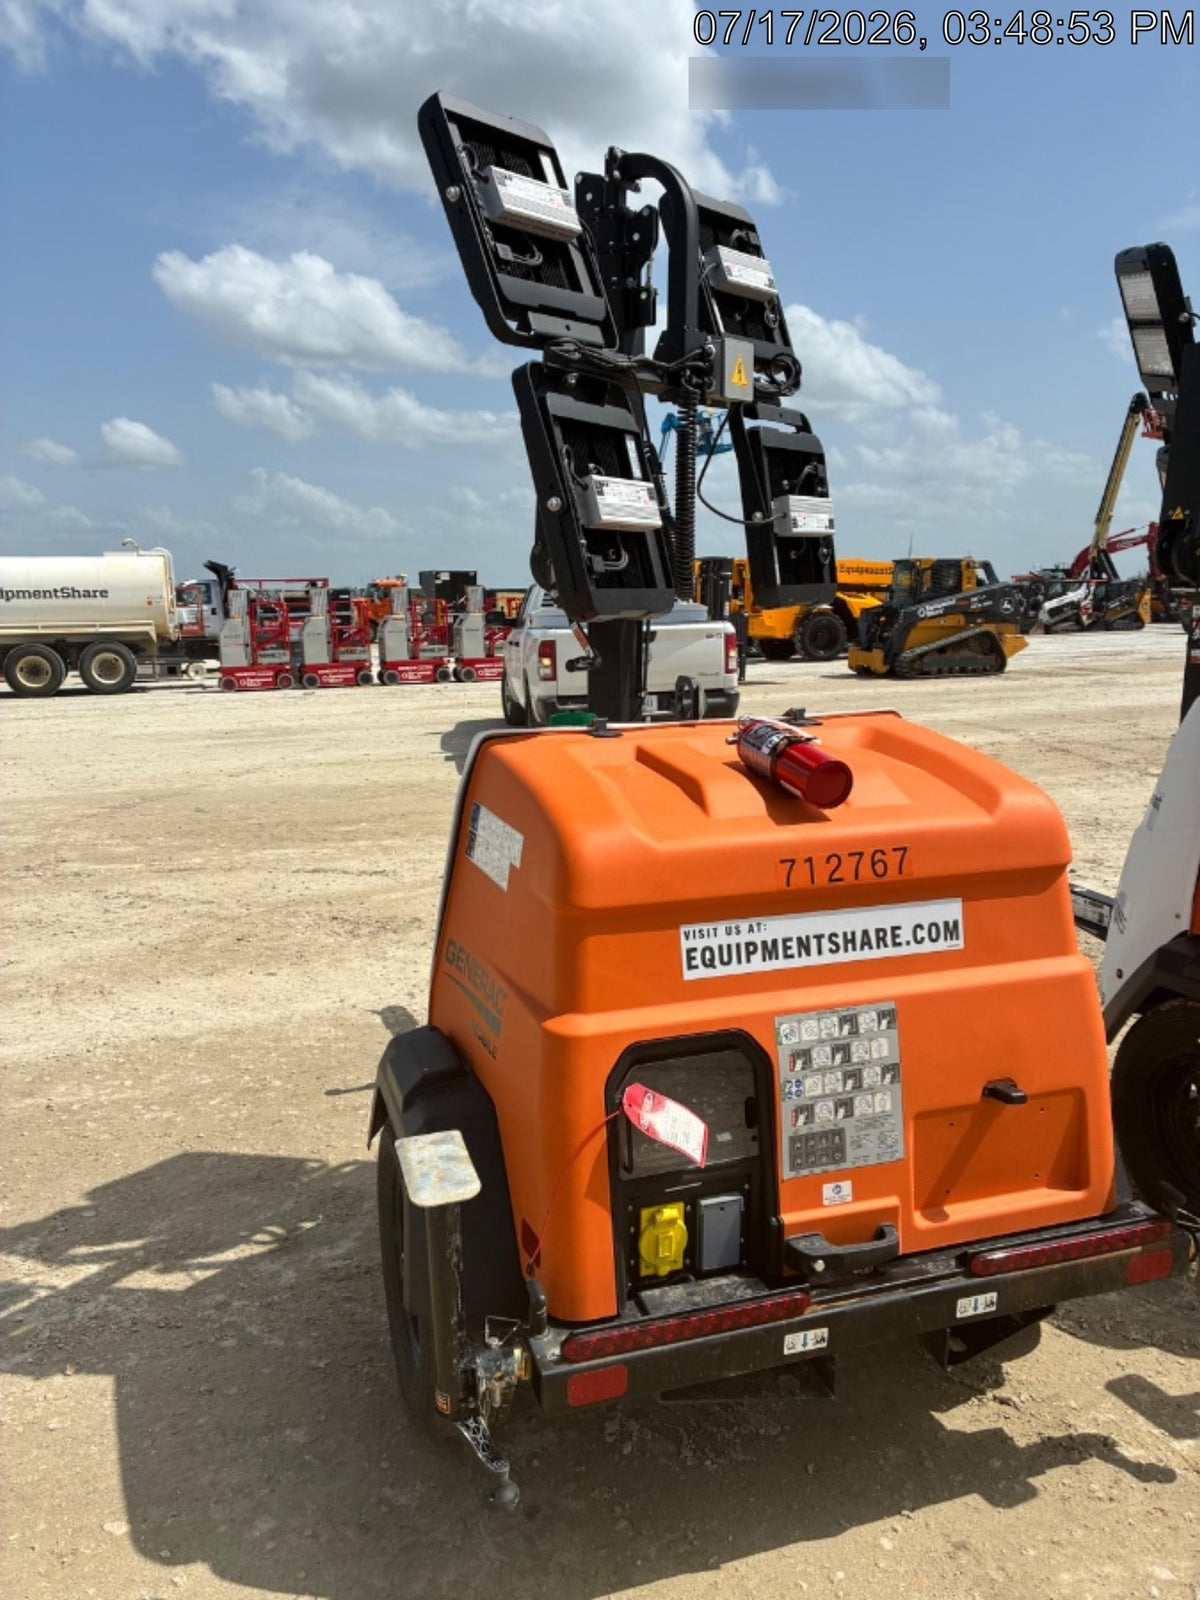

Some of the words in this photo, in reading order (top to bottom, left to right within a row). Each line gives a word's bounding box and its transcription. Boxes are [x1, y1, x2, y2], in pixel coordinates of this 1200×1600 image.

[779, 846, 909, 888] 712767
[684, 927, 718, 941] VISIT
[725, 924, 741, 936] US
[747, 921, 767, 934] AT:
[685, 918, 960, 971] EQUIPMENTSHARE.COM
